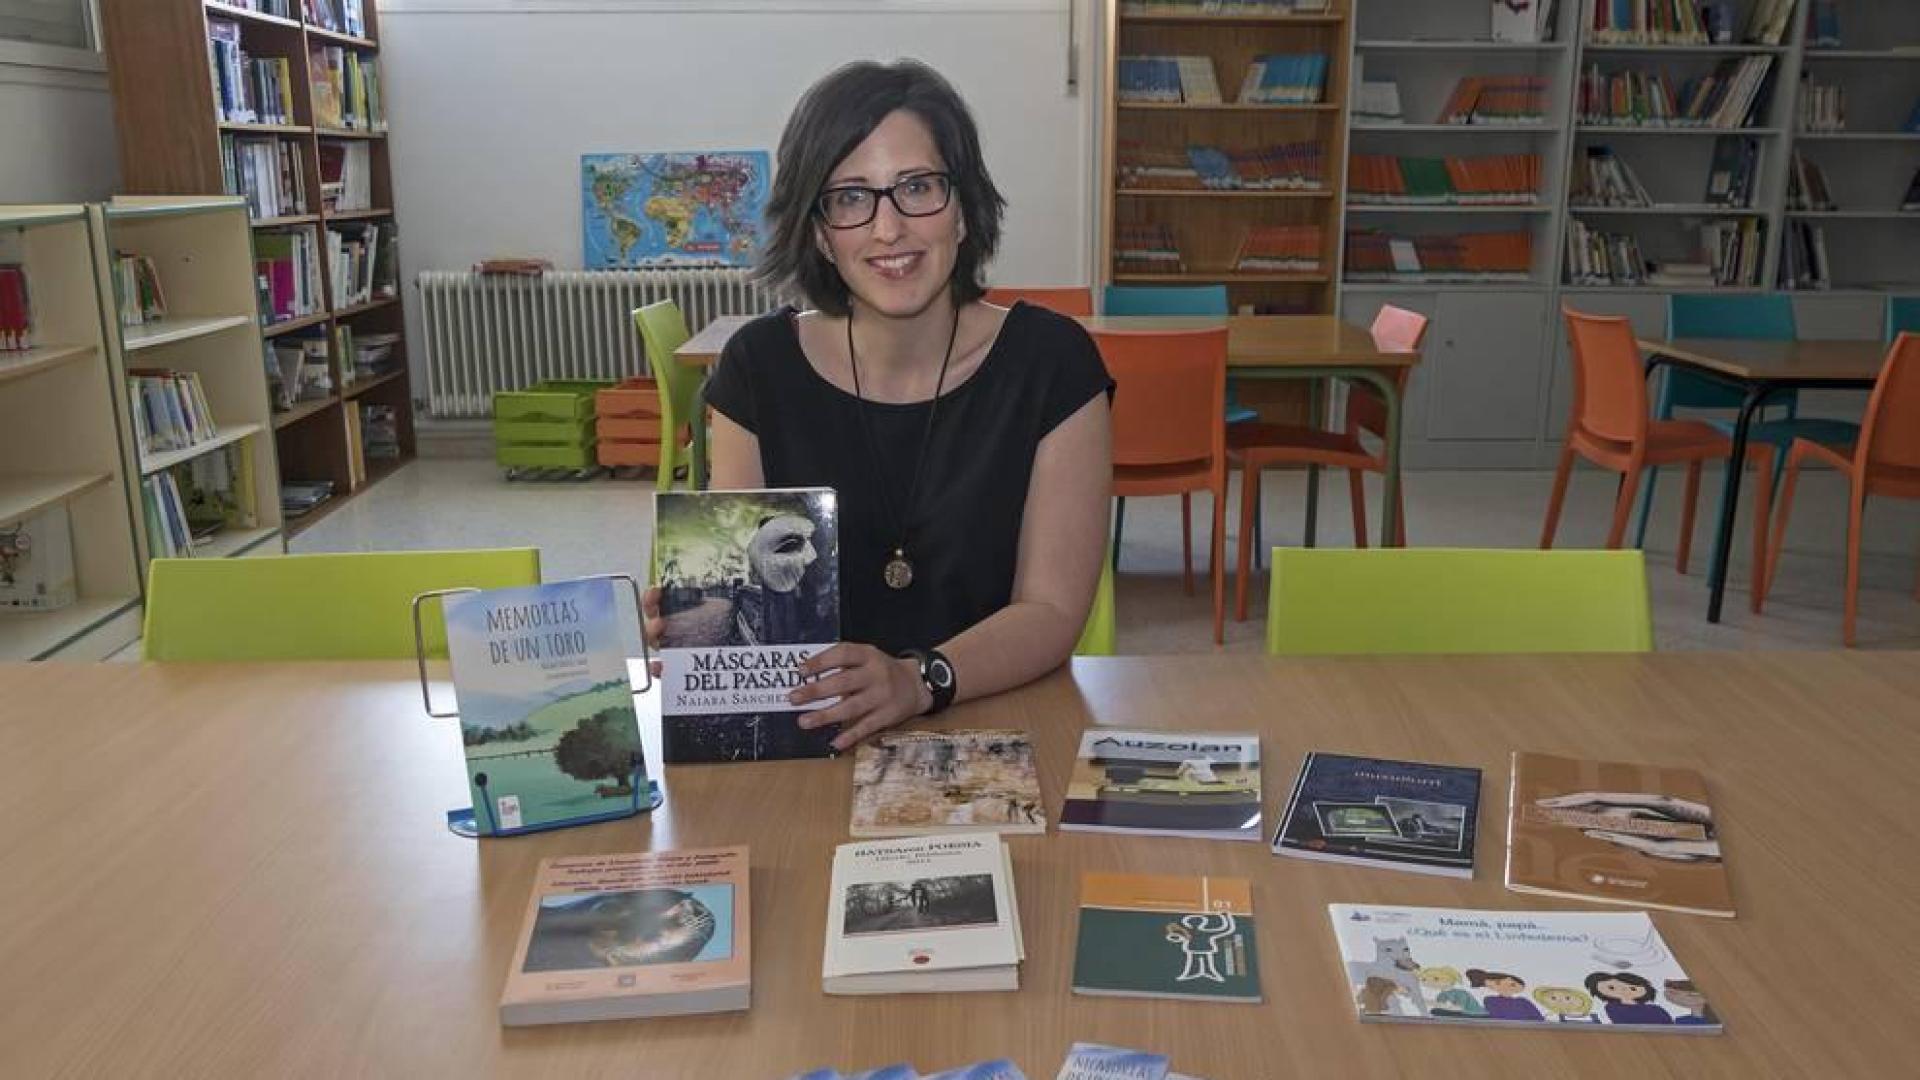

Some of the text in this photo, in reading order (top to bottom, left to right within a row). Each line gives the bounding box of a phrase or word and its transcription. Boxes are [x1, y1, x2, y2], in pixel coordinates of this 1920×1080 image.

[487, 599, 580, 632] MEMORIAS
[489, 630, 586, 664] DE UN TORO
[692, 649, 811, 671] MÁSCARAS
[684, 668, 820, 691] DEL PASAD
[1094, 737, 1242, 752] Auzolan
